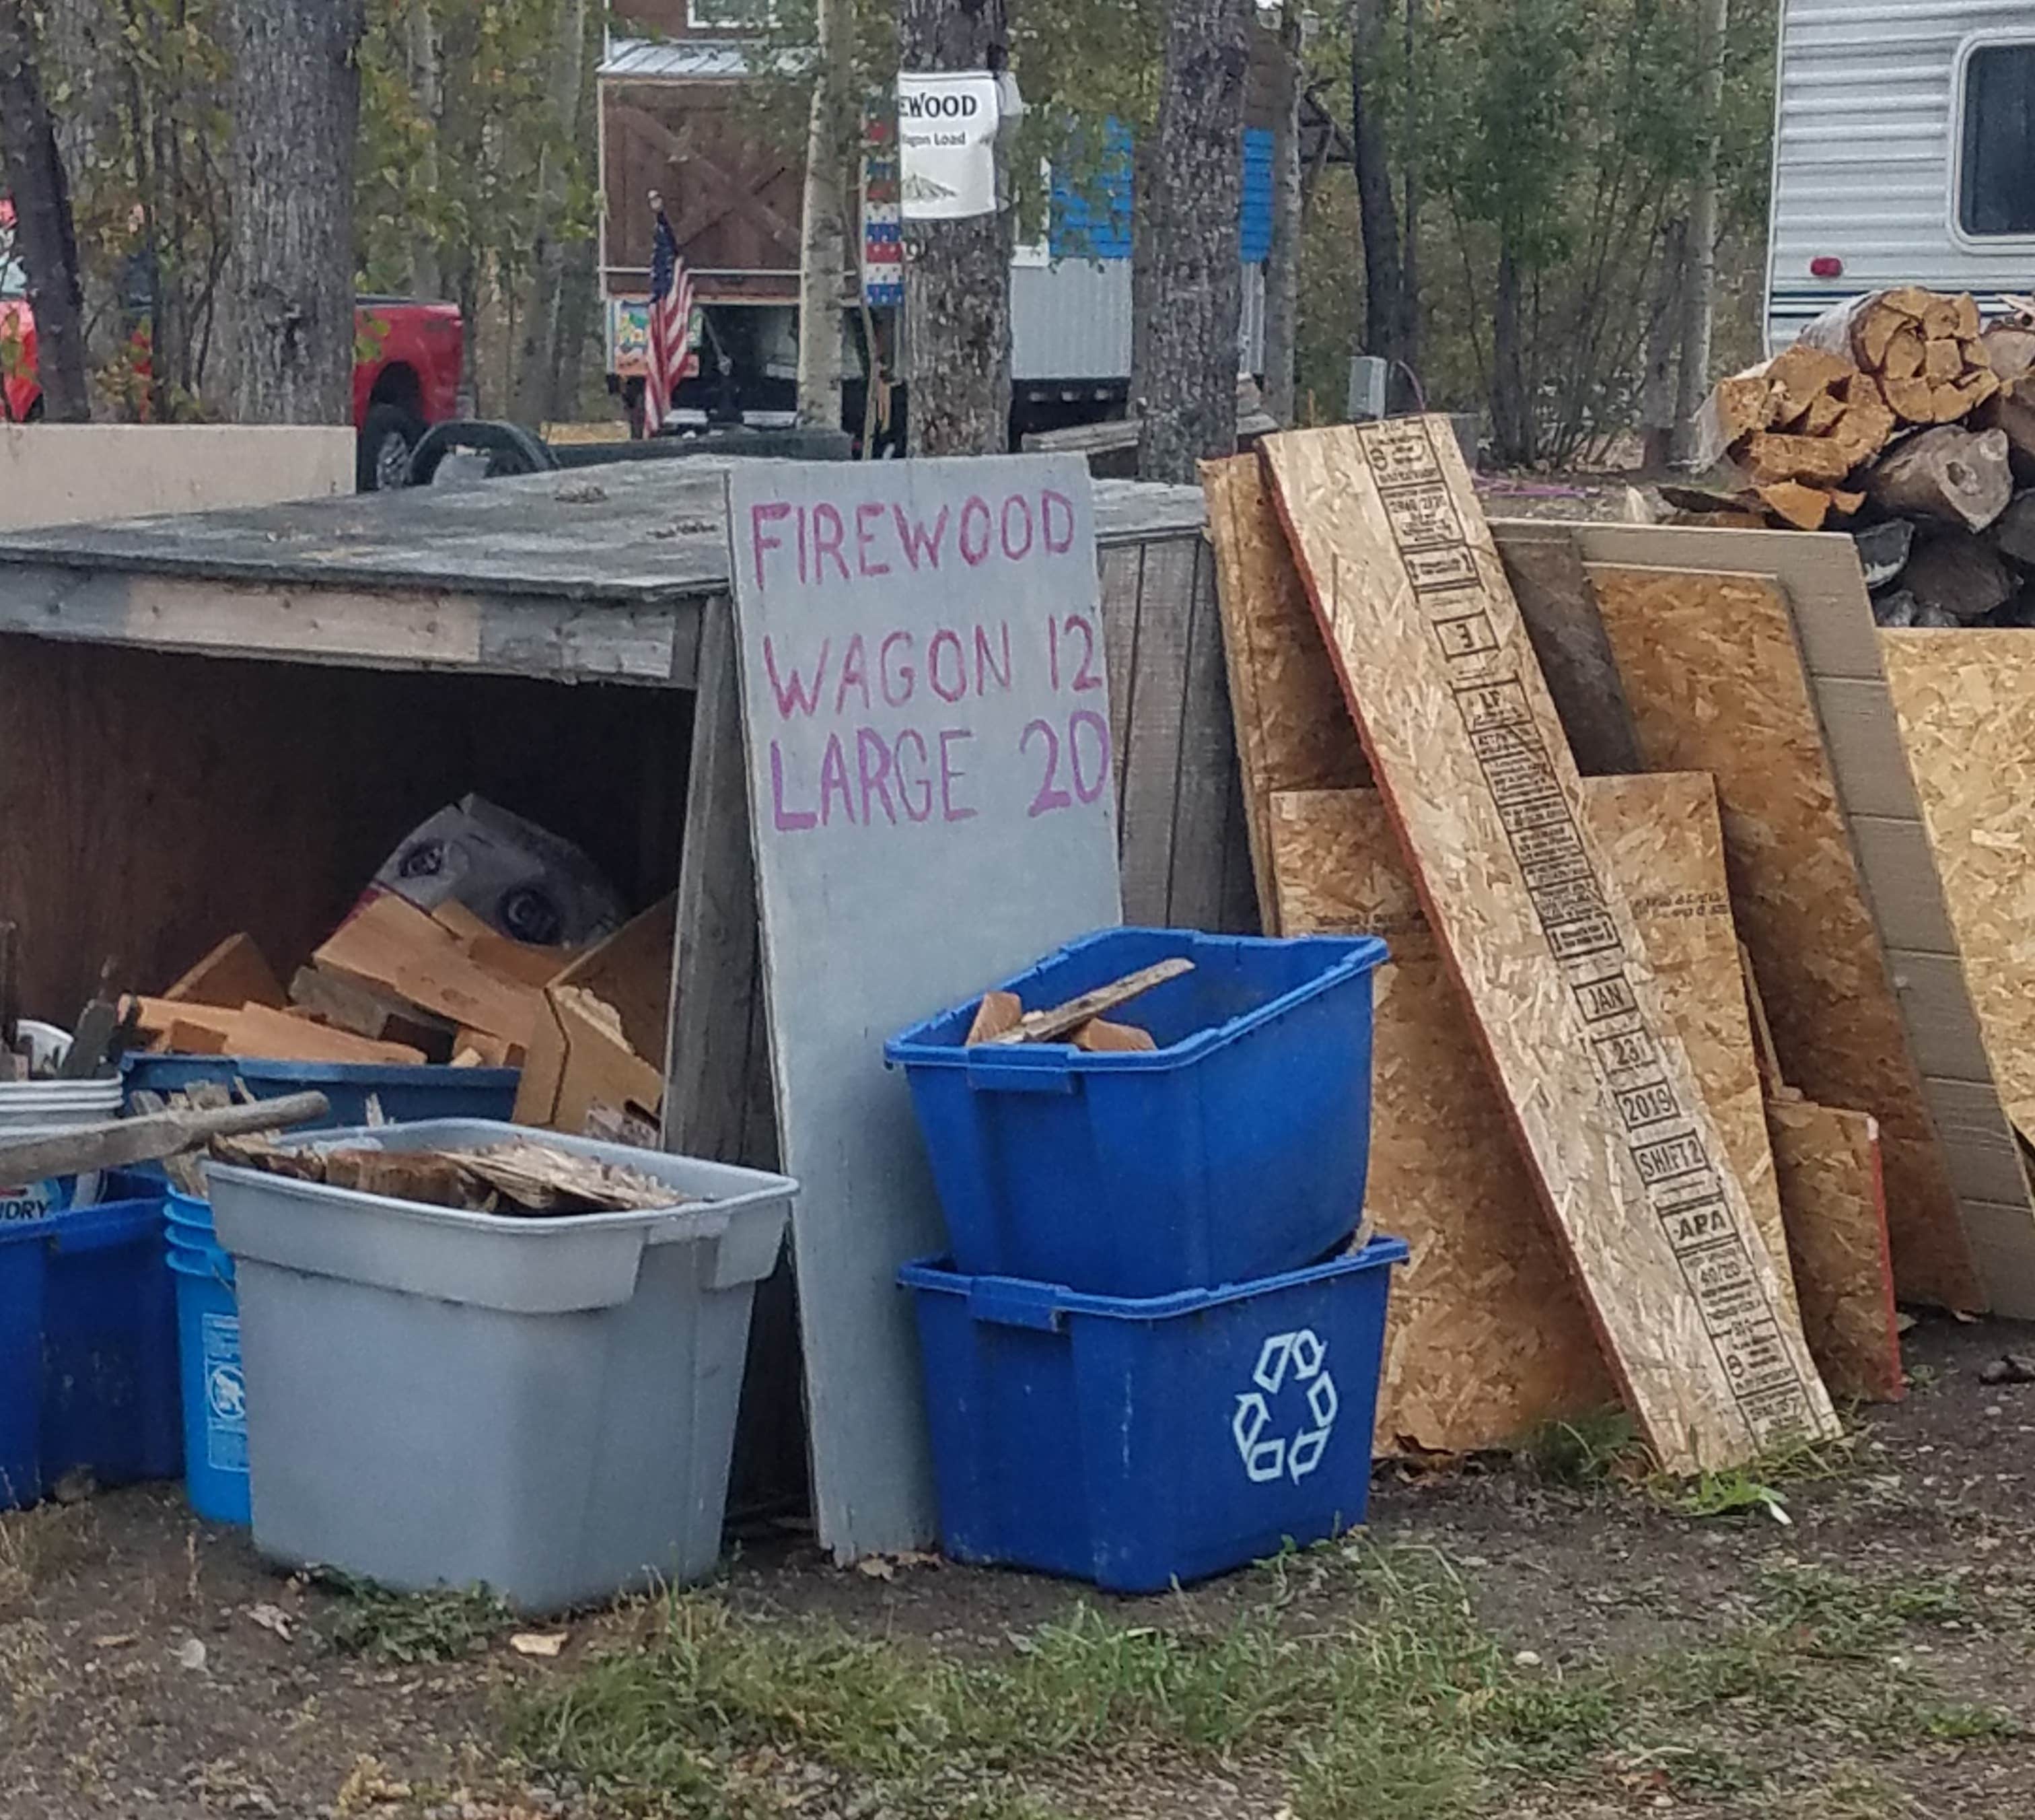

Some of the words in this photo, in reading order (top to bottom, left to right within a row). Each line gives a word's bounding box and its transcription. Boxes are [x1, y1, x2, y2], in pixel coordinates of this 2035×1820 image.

[933, 132, 966, 145] Load
[752, 489, 1075, 591] FIREWOOD
[764, 620, 1009, 720] WAGON
[1049, 615, 1103, 691] 12
[771, 727, 978, 831] LARGE
[1020, 710, 1110, 818] 20
[1589, 983, 1625, 1014] JAN
[1622, 1088, 1672, 1121] 2019
[0, 1200, 52, 1220] DRY
[1677, 1210, 1727, 1240] APA
